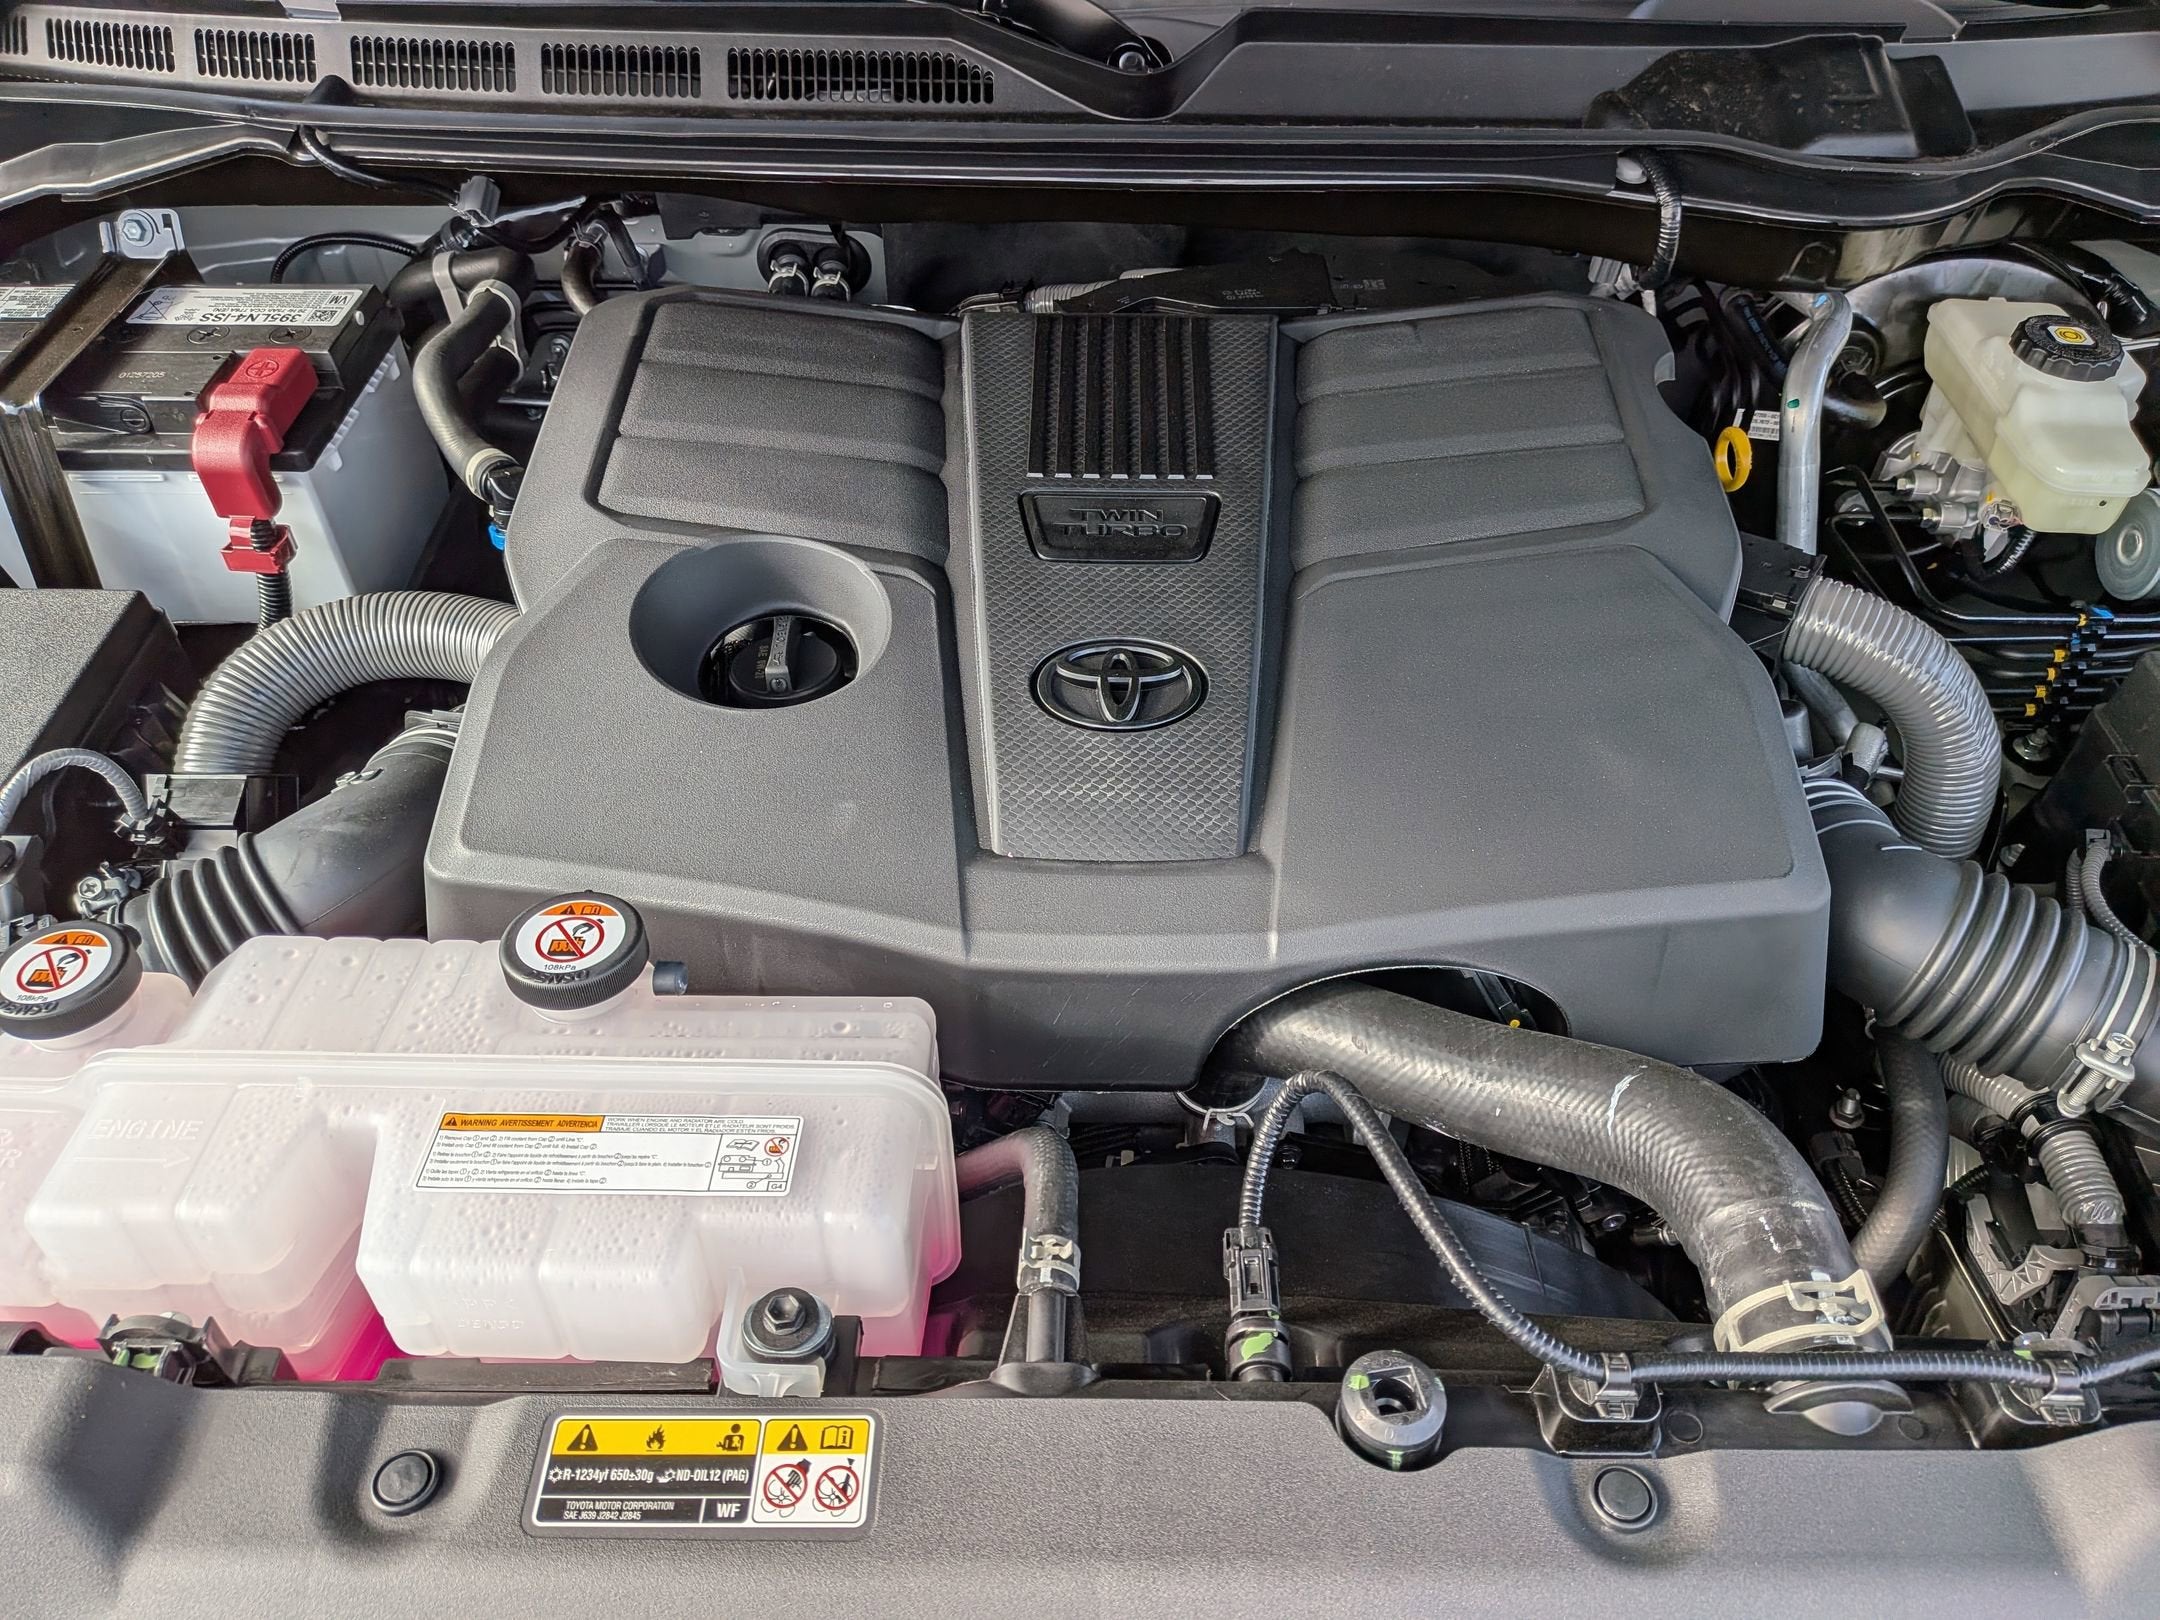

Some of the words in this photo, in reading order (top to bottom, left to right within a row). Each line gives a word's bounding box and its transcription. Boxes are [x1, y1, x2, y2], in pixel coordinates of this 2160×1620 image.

[328, 295, 348, 304] VM
[199, 312, 302, 323] 395LN4-ISS
[1070, 508, 1164, 521] TWIN
[1053, 522, 1189, 536] TURBO
[543, 963, 577, 971] 108kPa
[16, 993, 49, 1001] 108kPa
[460, 1119, 497, 1127] WARNING
[499, 1119, 554, 1127] AVERTISSEMENT
[556, 1120, 598, 1128] ADVERTENCIA
[88, 1119, 204, 1139] ENGINE
[563, 1468, 610, 1484] R-1234yf
[610, 1468, 655, 1484] 650±30g
[675, 1468, 722, 1481] ND-OIL12
[722, 1468, 750, 1484] (PAG)
[566, 1501, 594, 1510] TOYOTA
[595, 1501, 622, 1510] MOTOR
[622, 1501, 675, 1511] CORPORATION
[716, 1502, 742, 1518] WF
[563, 1511, 580, 1520] SAE
[578, 1511, 597, 1520] J639
[597, 1511, 619, 1520] J2842
[619, 1511, 642, 1520] J2845
